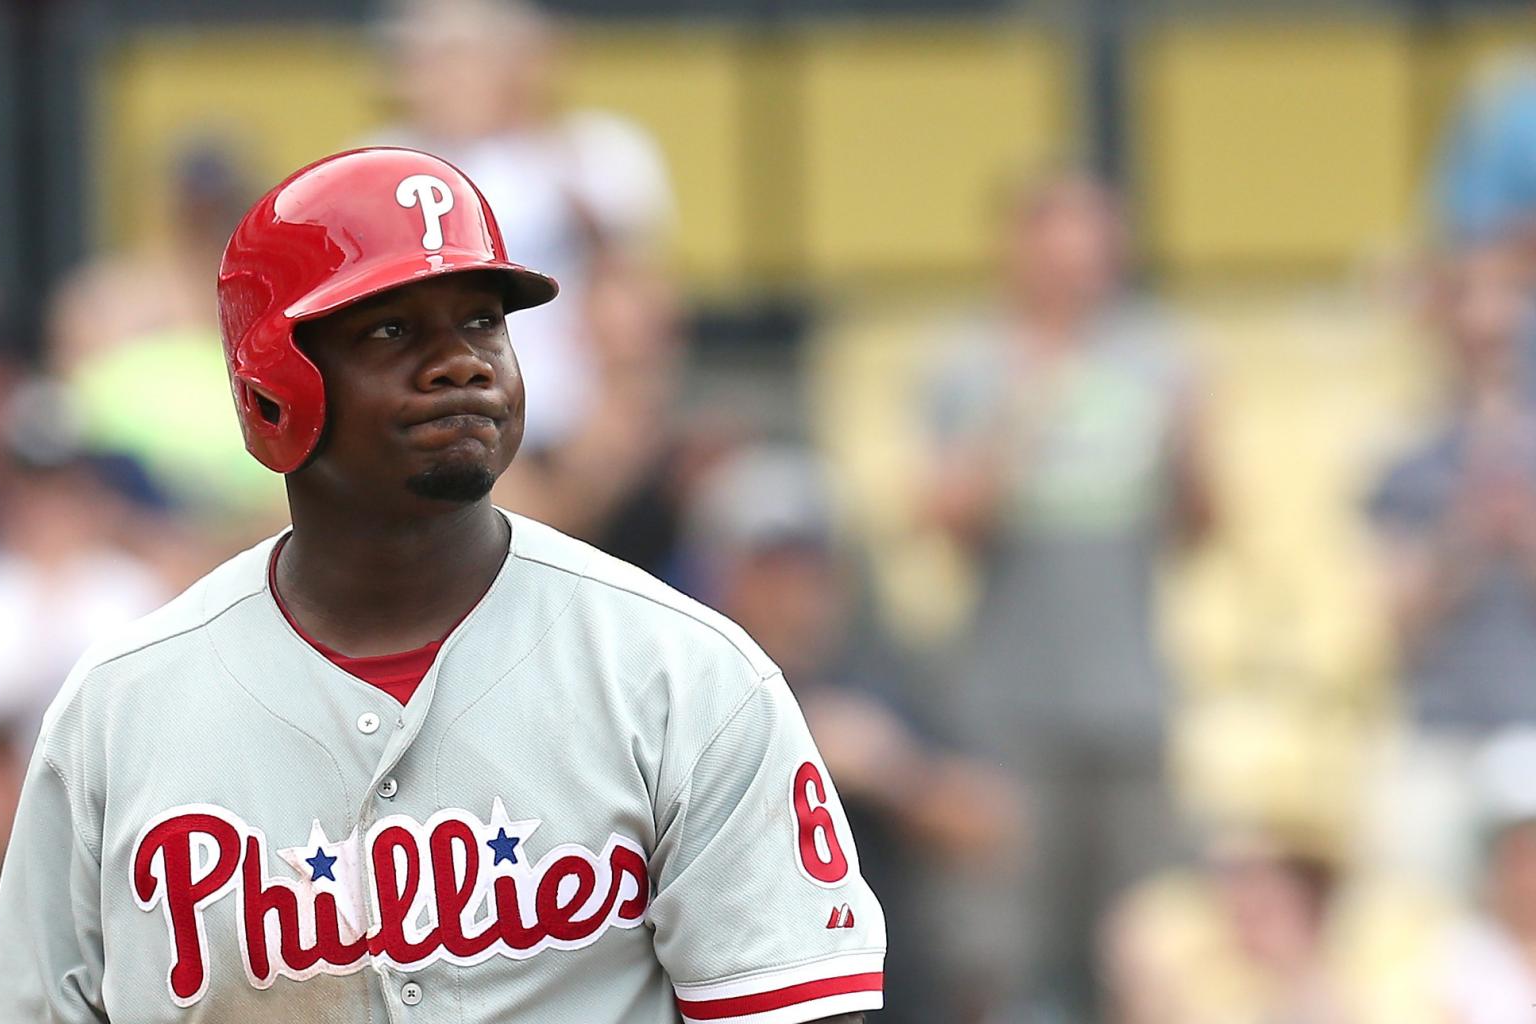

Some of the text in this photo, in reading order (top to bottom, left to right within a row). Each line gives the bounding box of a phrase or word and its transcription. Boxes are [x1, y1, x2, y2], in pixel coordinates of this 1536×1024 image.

[395, 173, 455, 251] P
[792, 760, 850, 885] 6
[131, 802, 652, 1007] Phillies
